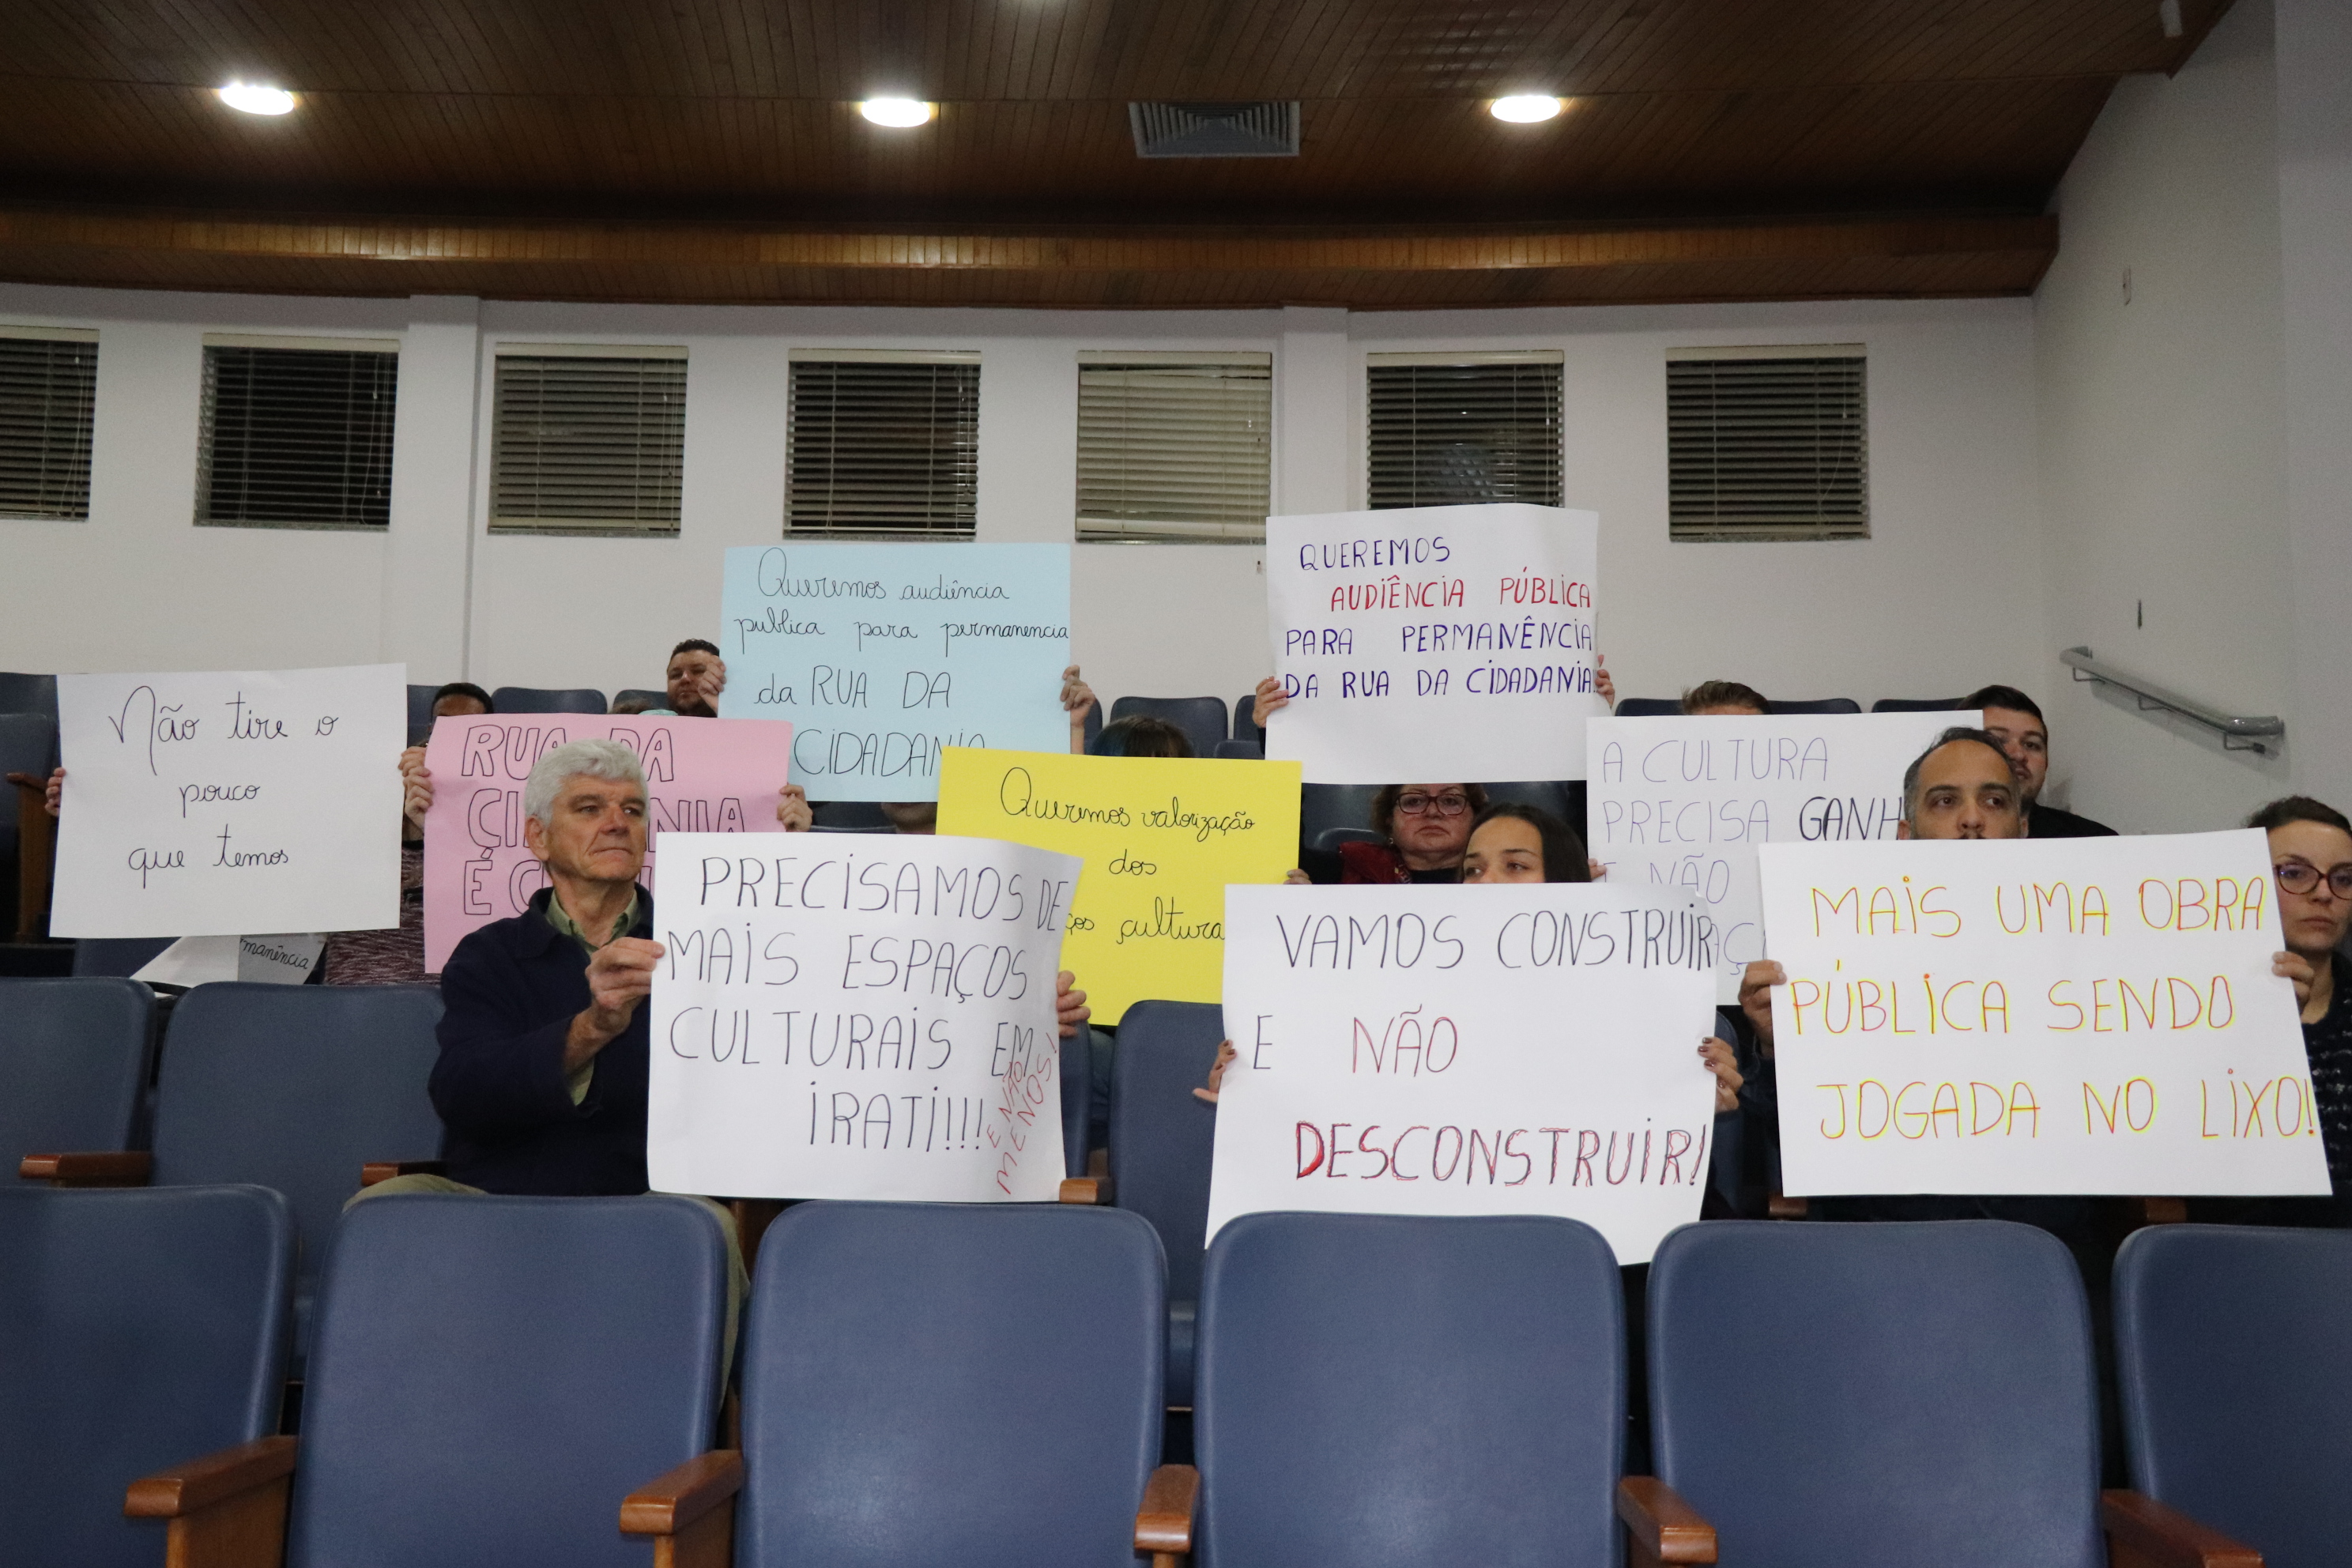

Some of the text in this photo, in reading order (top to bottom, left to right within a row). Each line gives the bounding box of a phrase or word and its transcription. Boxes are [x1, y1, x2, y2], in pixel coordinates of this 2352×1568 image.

[758, 548, 1009, 600] Queremos audiência
[1300, 537, 1449, 571] QUEREMOS
[1331, 567, 1590, 612] AUDIÊNCIA PÚBLICA
[733, 607, 825, 654] publica
[854, 622, 918, 652] para
[1287, 616, 1592, 656] PARA PERMANÊNCIA
[753, 665, 951, 708] da RUA DA
[1285, 673, 1317, 699] DA
[1342, 670, 1389, 698] RUA
[1417, 669, 1449, 696] DA
[108, 685, 339, 776] Não tire o
[1604, 737, 1827, 782] A CULTURA
[179, 785, 260, 818] pouco
[1001, 767, 1255, 842] Queremos valorização
[1603, 797, 1902, 844] PRECISA GANH
[128, 824, 288, 889] que temos
[1109, 849, 1157, 876] dos
[701, 854, 1024, 921] PRECISAMOS
[1037, 879, 1069, 931] DE
[1116, 896, 1225, 944] cultura
[1811, 876, 2264, 937] MAIS UMA OBRA
[239, 938, 308, 969] manência
[667, 922, 1027, 1004] MAIS ESPAÇOS
[1276, 913, 1464, 970] VAMOS
[1498, 903, 1713, 971] CONSTRUIR
[1789, 959, 2236, 1035] PÚBLICA SENDO
[670, 1007, 1033, 1077] CULTURAIS EM
[1253, 1004, 1457, 1077] E NÃO
[810, 1081, 983, 1152] IRATI!!!
[1817, 1069, 2315, 1140] JOGADA NO LIXO!
[1295, 1118, 1707, 1187] DESCONSTRUIR!
